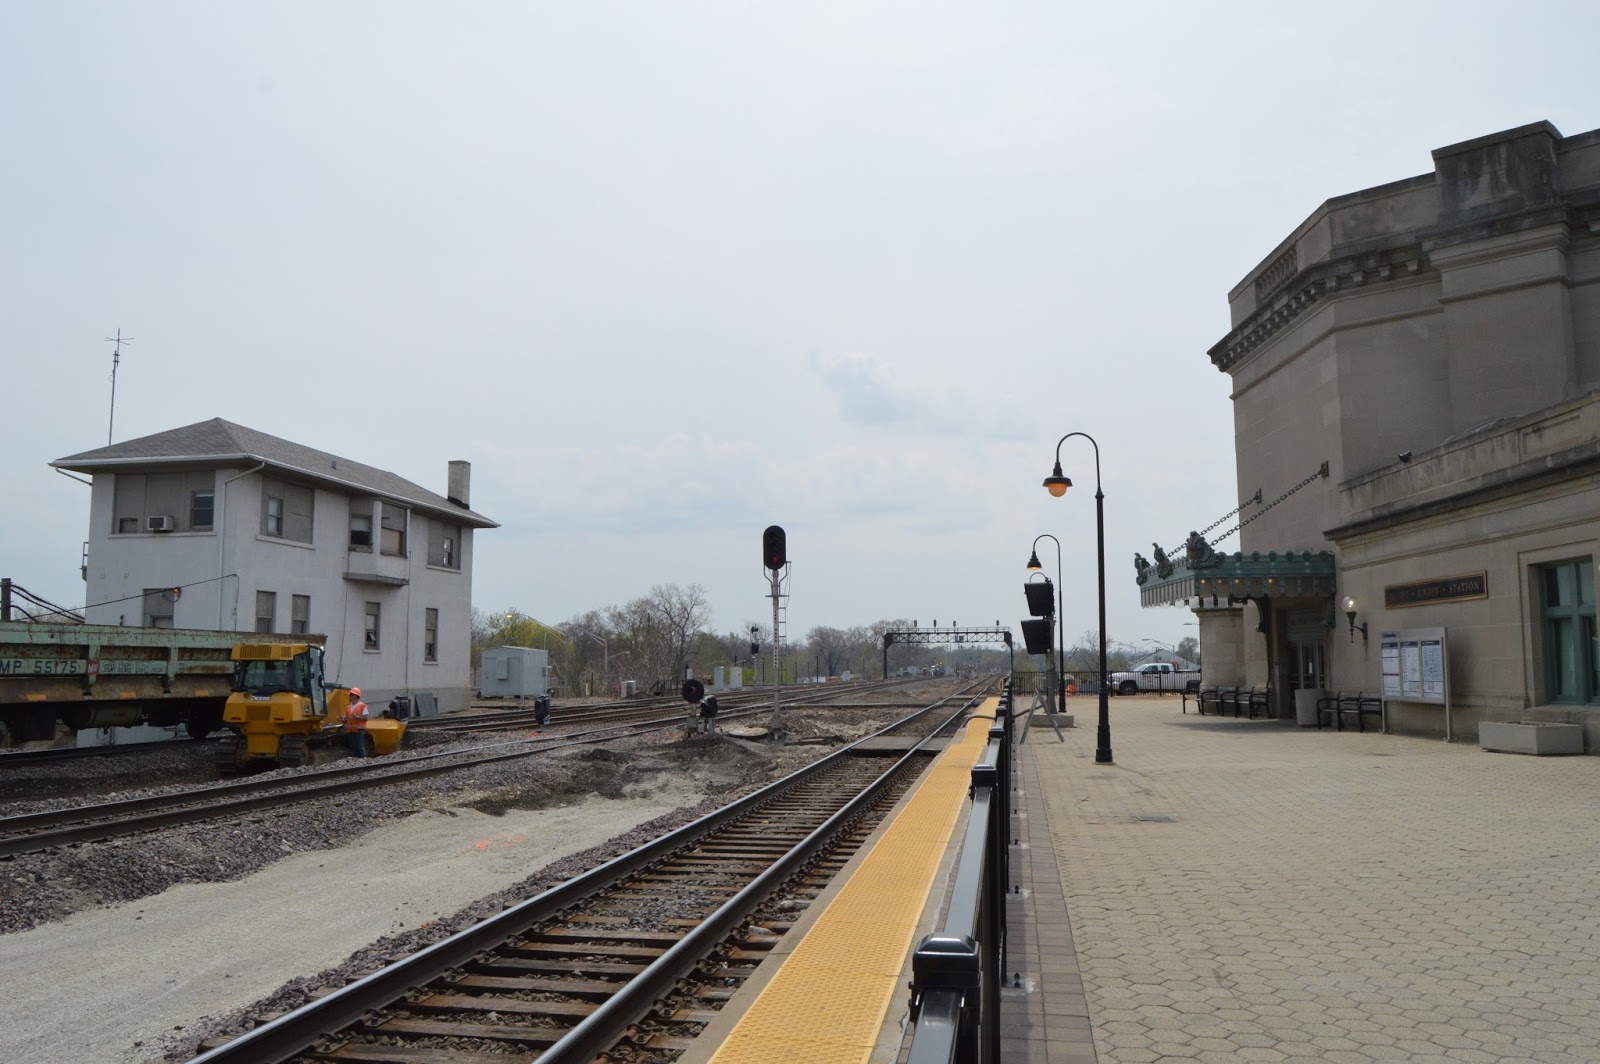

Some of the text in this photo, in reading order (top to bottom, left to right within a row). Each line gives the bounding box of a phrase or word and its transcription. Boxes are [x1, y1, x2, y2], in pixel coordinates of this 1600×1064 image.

[1417, 586, 1440, 597] UNION
[1448, 581, 1480, 593] STATION
[0, 660, 22, 674] MP
